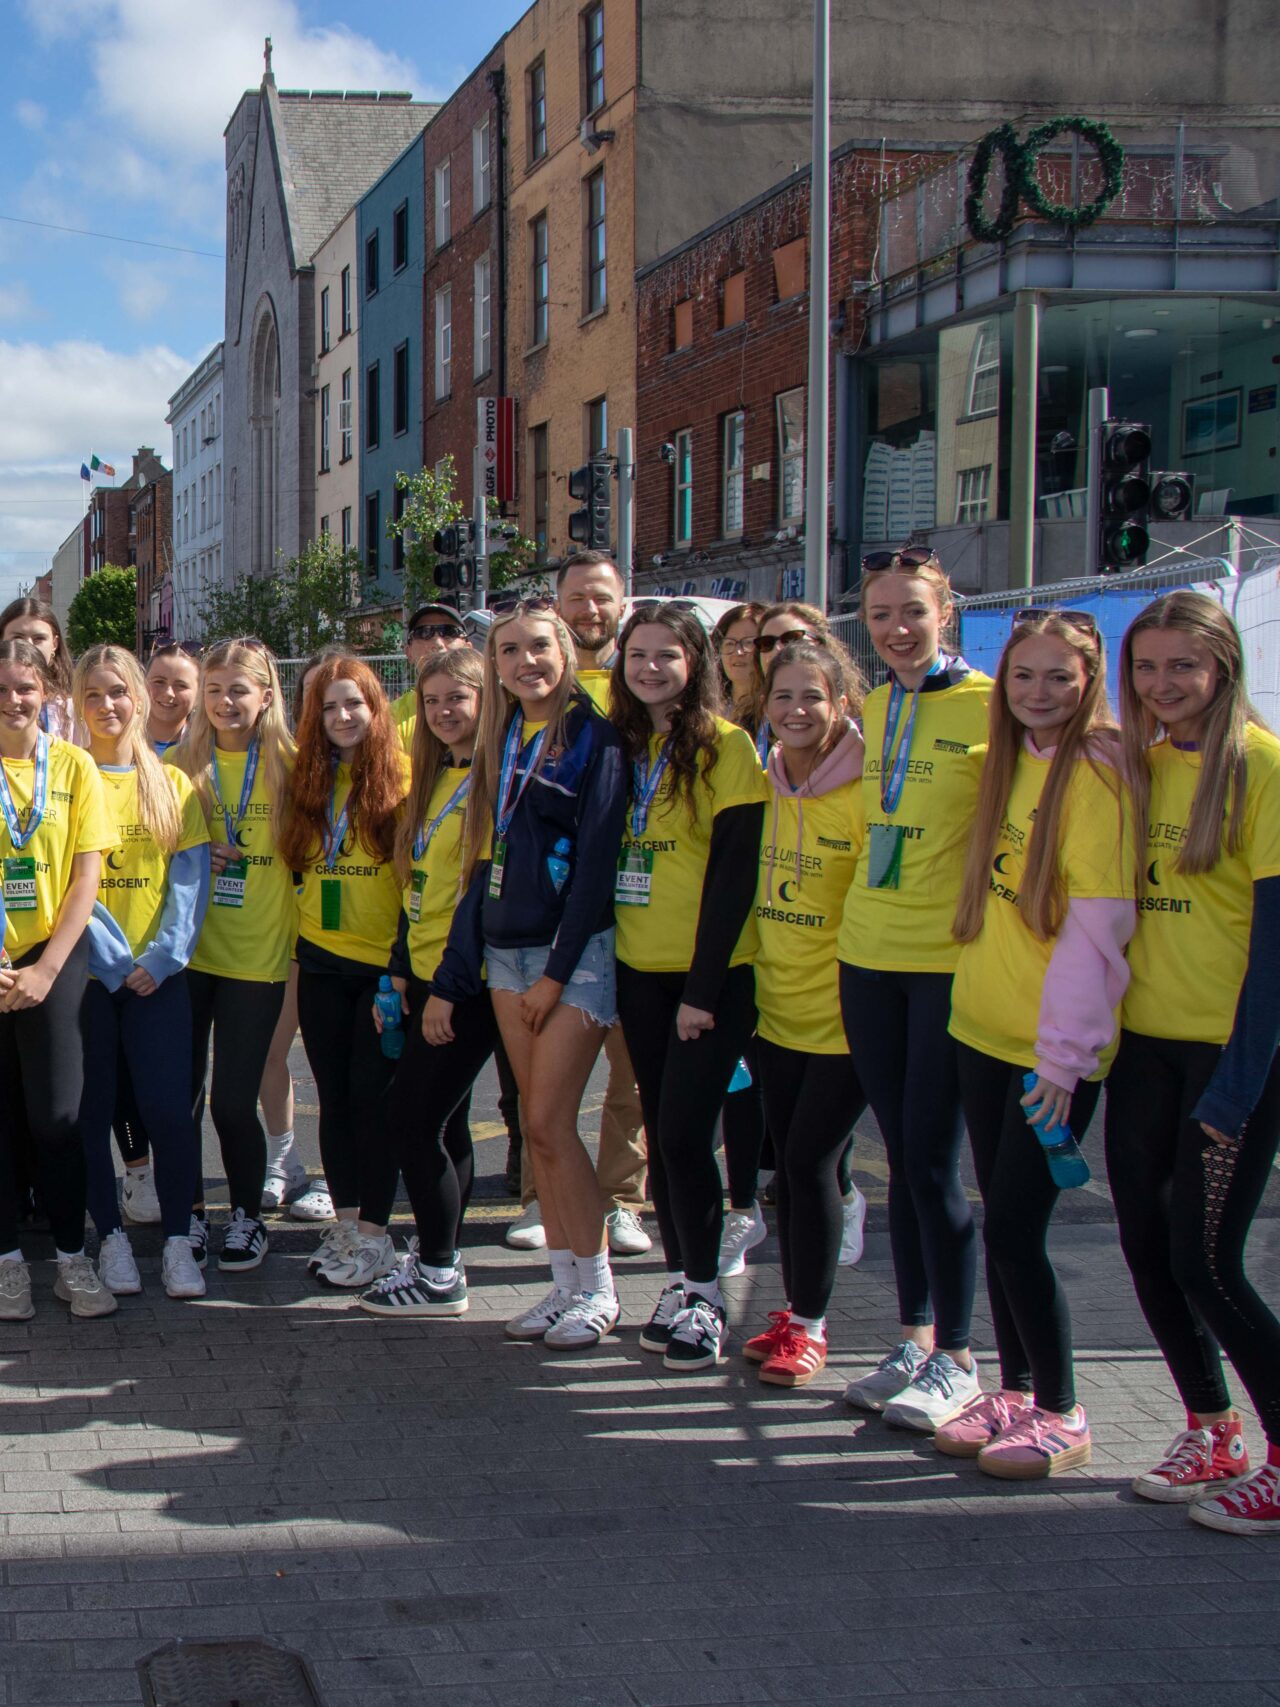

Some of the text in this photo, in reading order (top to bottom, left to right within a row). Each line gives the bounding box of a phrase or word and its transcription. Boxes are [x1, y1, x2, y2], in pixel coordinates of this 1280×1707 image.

[486, 400, 496, 497] AGFA PHOTO
[315, 864, 381, 877] CRESCENT
[99, 877, 151, 889] ESCENT
[217, 879, 245, 889] EVENT
[618, 874, 650, 884] EVENT
[6, 881, 35, 891] EVENT
[617, 882, 649, 890] VOLUNTEER
[6, 888, 36, 896] VOLUNTEER
[756, 905, 826, 928] CRESCENT
